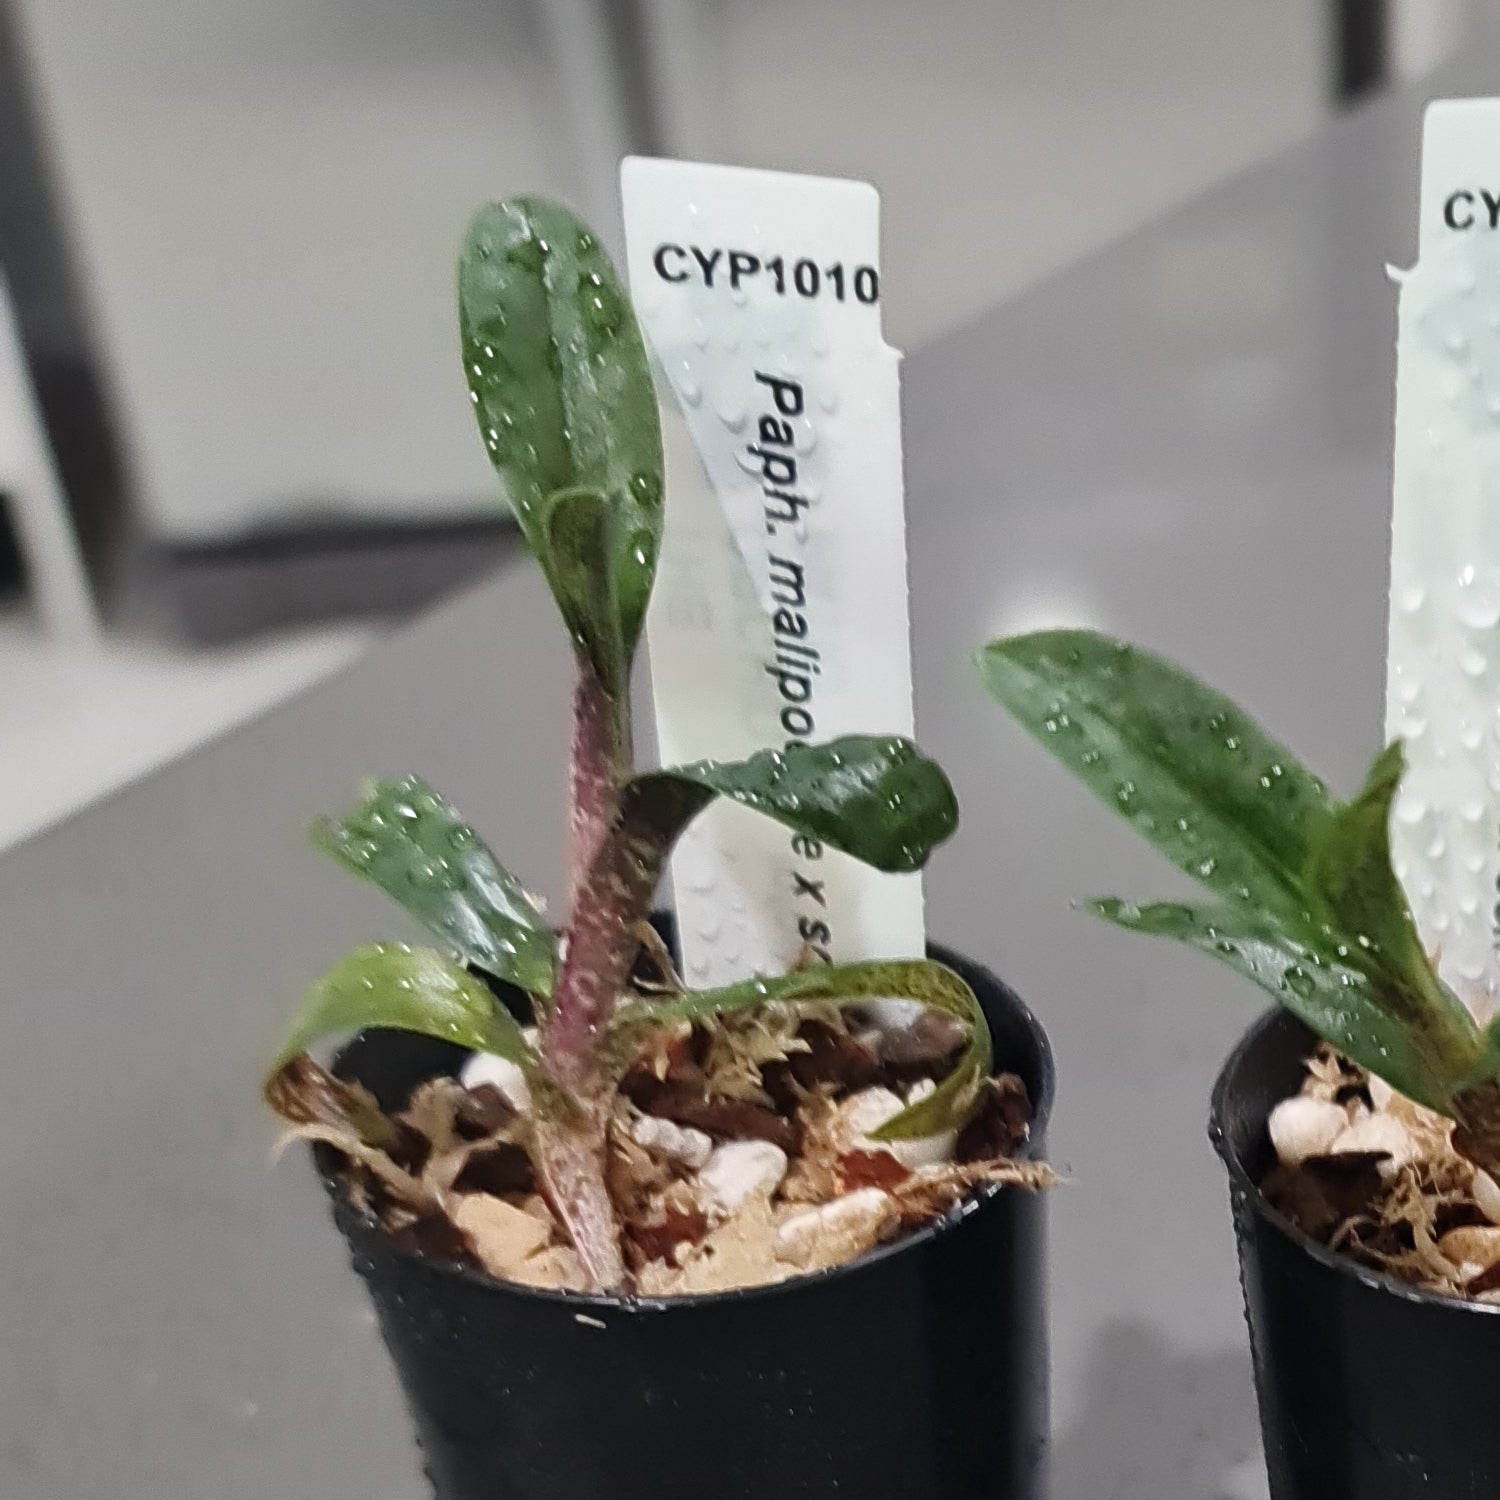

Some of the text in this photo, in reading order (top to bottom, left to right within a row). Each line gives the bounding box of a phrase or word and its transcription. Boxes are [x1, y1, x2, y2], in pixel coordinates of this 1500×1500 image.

[653, 242, 880, 305] CYP1010
[746, 369, 809, 535] Paph.
[764, 553, 824, 860] malipoe
[792, 870, 827, 907] x
